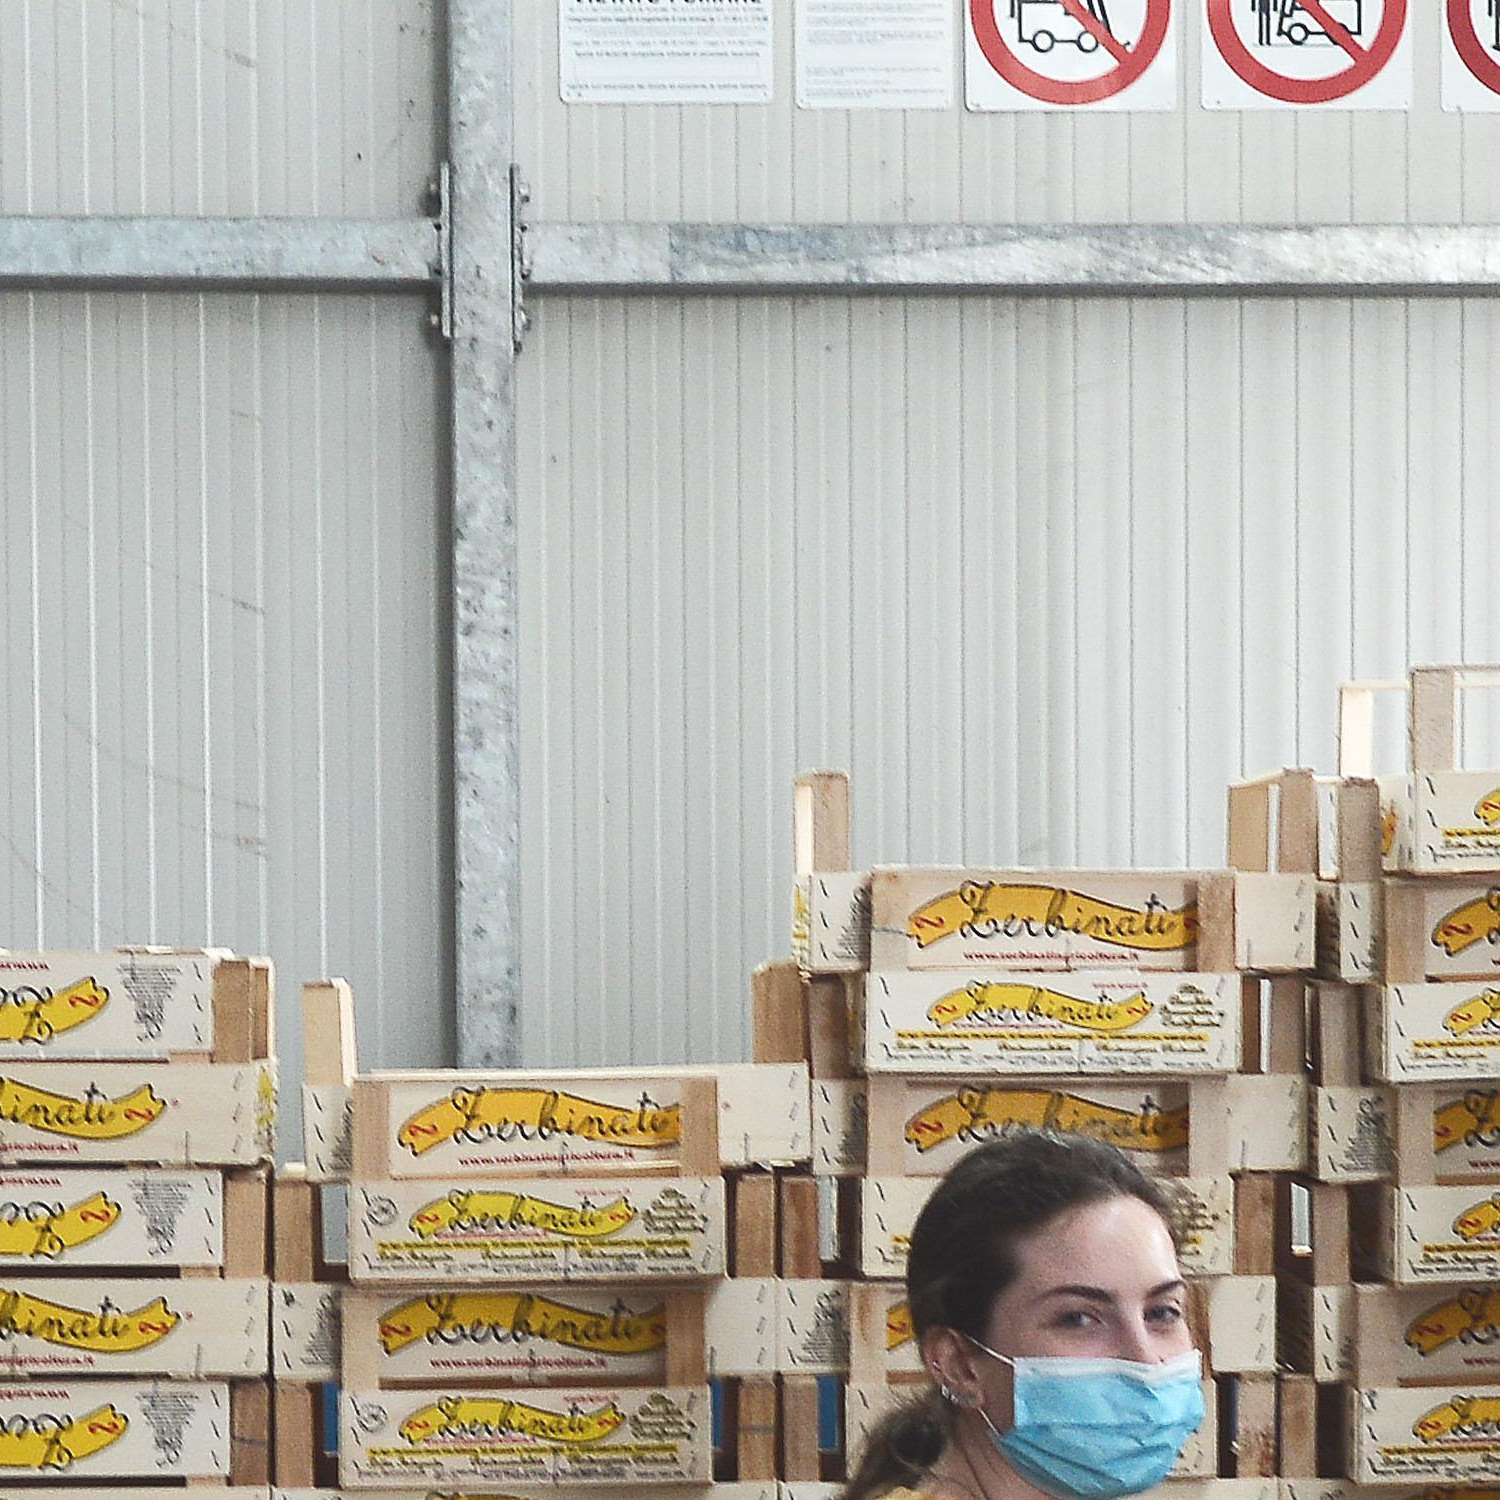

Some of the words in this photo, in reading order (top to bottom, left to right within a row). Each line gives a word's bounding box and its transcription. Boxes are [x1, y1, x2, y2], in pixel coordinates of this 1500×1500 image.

[959, 879, 1176, 939] Zerbinati
[451, 1086, 668, 1144] Zerbinati
[448, 1188, 598, 1232] Zerbinati
[426, 1291, 638, 1344] Zerbinati
